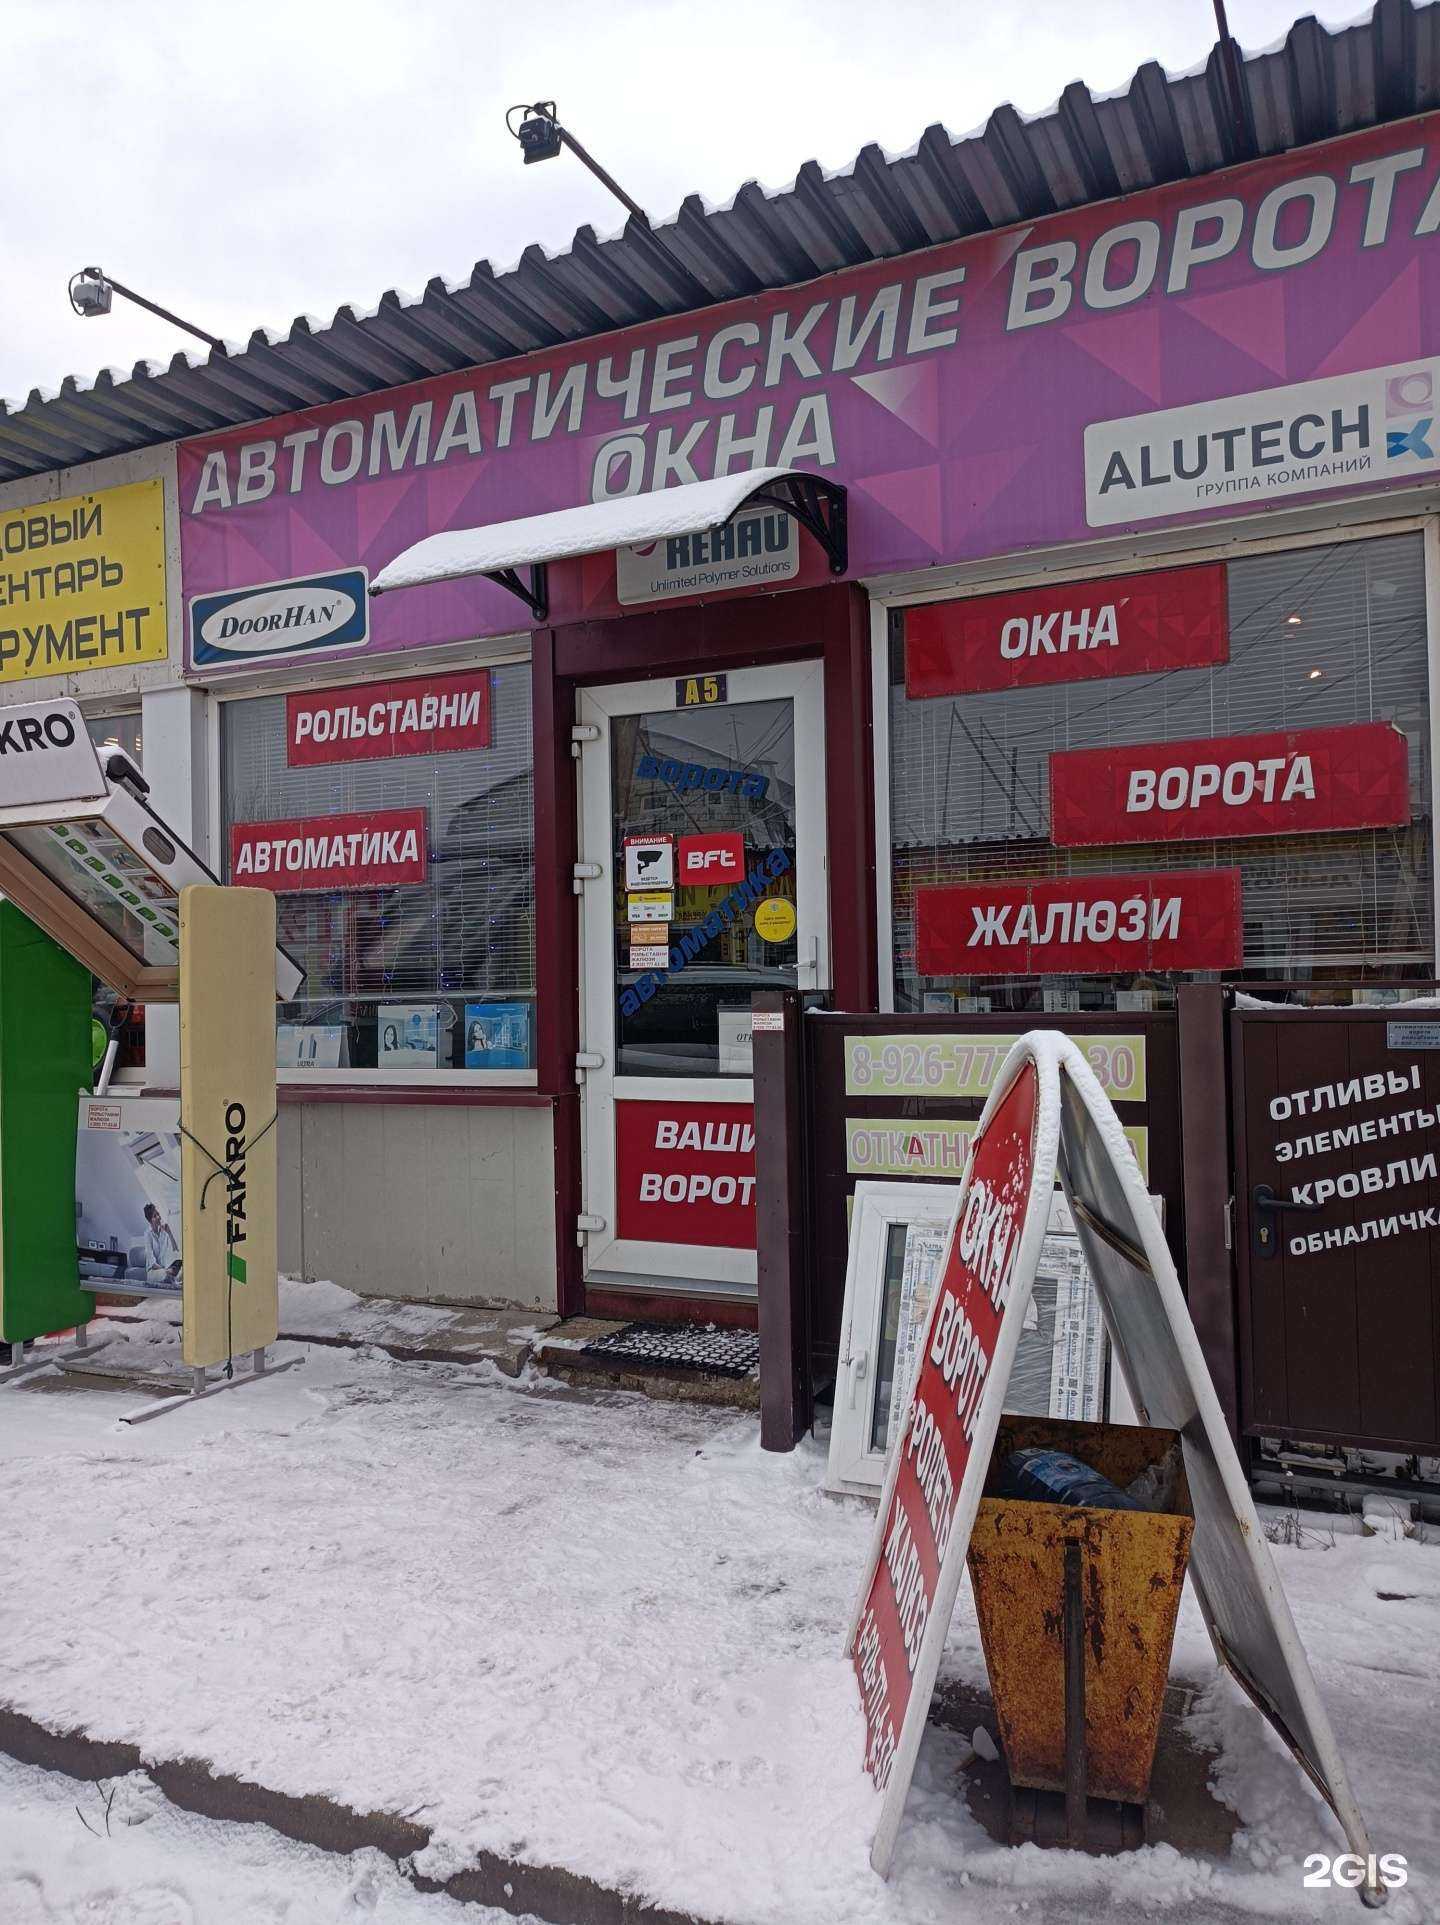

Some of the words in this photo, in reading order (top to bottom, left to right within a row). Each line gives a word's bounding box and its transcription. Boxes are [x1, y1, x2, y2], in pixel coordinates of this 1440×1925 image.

[192, 266, 966, 514] АВТОМАТИЧЕСКИЕ
[592, 394, 836, 503] ОКНА
[1098, 404, 1370, 494] ALUTECH
[1196, 475, 1261, 498] ГРУППА
[1267, 455, 1371, 486] КОМПАНИЙ
[0, 503, 102, 561] ОВЫЙ
[666, 513, 789, 570] REHAU
[650, 573, 697, 593] Unlimited
[698, 569, 740, 585] Polymer
[741, 559, 791, 578] Solutions
[999, 604, 1120, 659] ОКНА
[294, 690, 481, 745] РОЛЬСТАВНИ
[1126, 755, 1317, 813] ВОРОТА
[235, 829, 419, 874] АВТОМАТИКА
[630, 836, 667, 846] ВНИМАНИЕ
[967, 897, 1182, 947] ЖАЛЮЗИ
[1269, 1065, 1421, 1121] ОТЛИВЫ
[1274, 1104, 1440, 1162] ЭЛЕМЕНТЫ
[226, 1102, 247, 1246] FAKRO
[639, 1173, 757, 1206] ВОРОТ
[1291, 1153, 1438, 1205] КРОВЛИ
[1290, 1207, 1440, 1256] ОБНАЛИЧК
[885, 1496, 927, 1673] ЖАЛЮЗ
